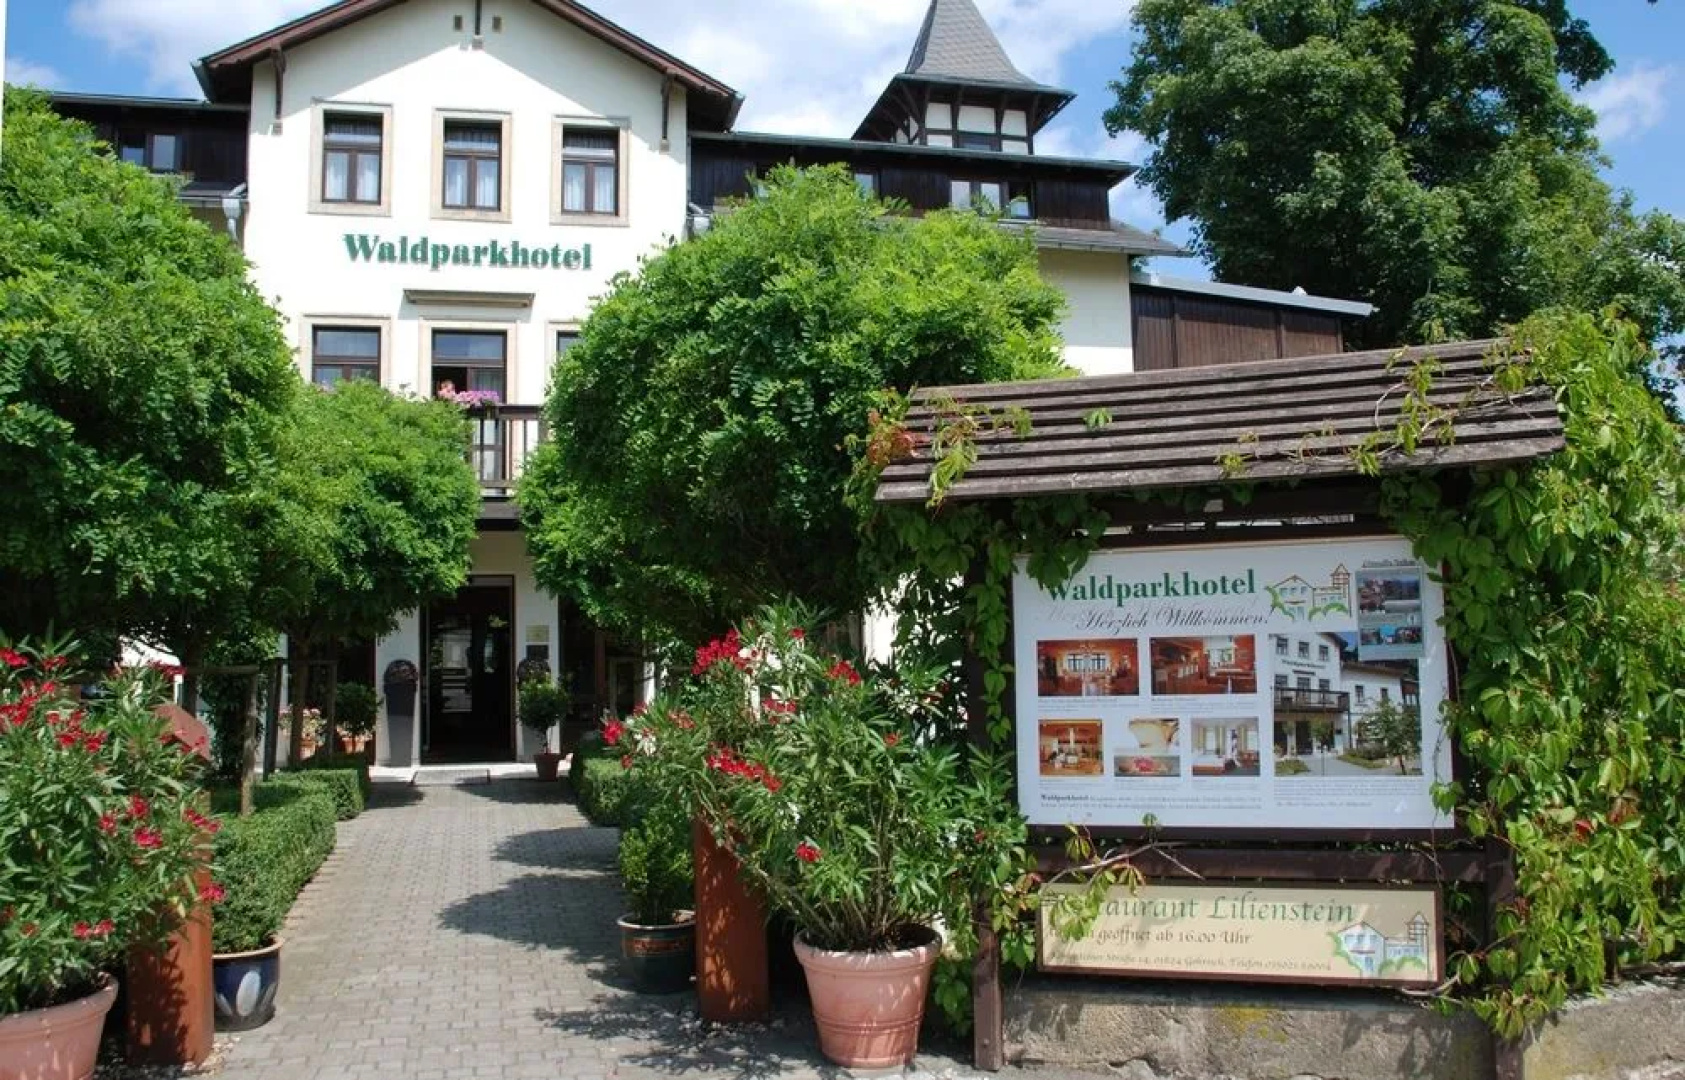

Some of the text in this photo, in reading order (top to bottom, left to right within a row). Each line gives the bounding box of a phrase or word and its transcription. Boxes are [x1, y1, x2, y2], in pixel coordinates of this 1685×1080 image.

[343, 233, 592, 271] Waldparkhotel
[1048, 569, 1256, 607] Waldparkhotel
[1076, 610, 1148, 635] Herzlich
[1207, 891, 1353, 922] Lilienstein
[1155, 927, 1174, 943] ab
[1178, 931, 1216, 943] 16.00
[1220, 927, 1252, 944] Uhr
